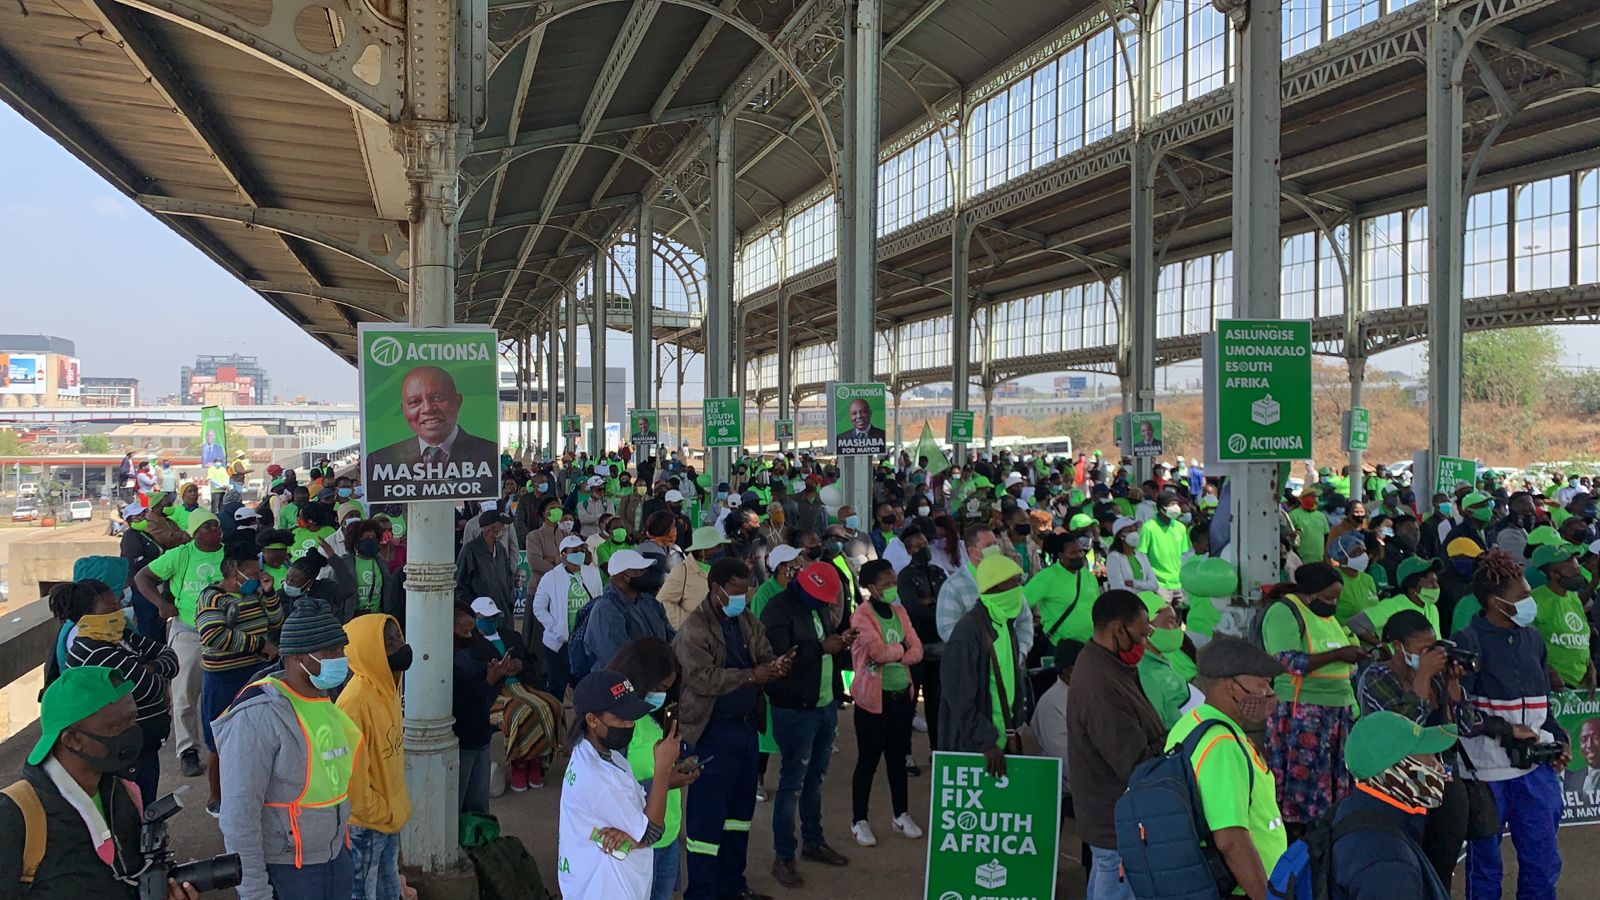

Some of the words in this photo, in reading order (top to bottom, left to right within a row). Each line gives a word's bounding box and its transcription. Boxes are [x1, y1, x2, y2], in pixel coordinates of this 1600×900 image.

[1225, 329, 1295, 340] ASILUNGISE
[406, 342, 490, 361] ACTIONSA
[1225, 345, 1306, 356] UMONAKALO
[1225, 361, 1273, 372] ESOUTH
[1225, 377, 1270, 388] AFRIKA
[838, 438, 885, 447] MASHABA
[1250, 436, 1303, 450] ACTIONSA
[372, 461, 493, 481] MASHABA
[1441, 461, 1462, 471] LET'S
[1440, 469, 1455, 477] FIX
[383, 483, 417, 497] FOR
[422, 481, 482, 497] MAYOR
[941, 788, 984, 809] FIX
[941, 810, 1033, 833] SOUTH
[939, 833, 1038, 856] AFRICA
